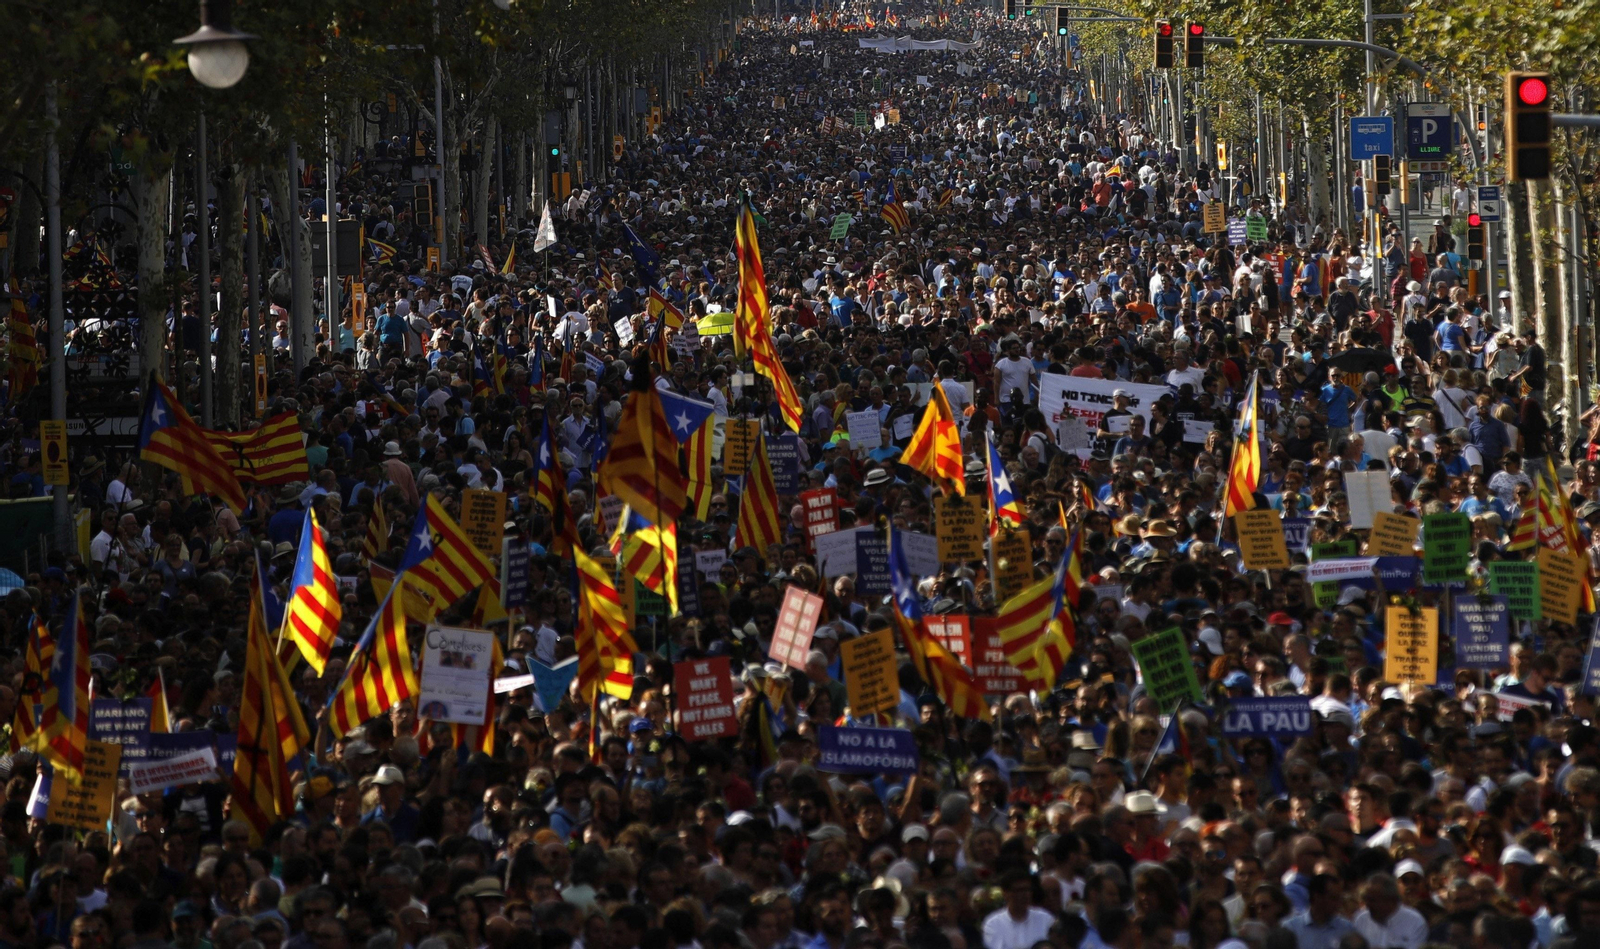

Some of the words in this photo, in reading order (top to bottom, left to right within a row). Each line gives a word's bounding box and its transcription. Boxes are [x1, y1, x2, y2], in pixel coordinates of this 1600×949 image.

[1422, 118, 1439, 144] P
[1364, 143, 1381, 152] taxi
[1061, 389, 1079, 402] NO
[958, 510, 976, 518] VOL
[858, 539, 887, 548] MARIA
[863, 548, 888, 556] VOLE
[871, 565, 885, 573] NO
[1494, 564, 1536, 574] IMAGINA
[862, 574, 892, 582] VENDR
[1464, 613, 1500, 623] VOLEM
[1471, 624, 1494, 634] PAU,
[1411, 639, 1427, 647] PAZ
[1473, 635, 1489, 643] NO
[1463, 644, 1503, 653] VENDRE
[1394, 656, 1431, 664] TRAFICA
[1466, 654, 1500, 663] ARMES
[694, 662, 710, 676] WE
[998, 664, 1022, 677] ARM
[690, 676, 718, 692] WANT
[986, 680, 1018, 692] SALES
[95, 708, 149, 720] MARIANO,
[682, 710, 702, 723] NOT
[703, 706, 733, 721] ARMS
[95, 723, 112, 732] WE
[114, 722, 147, 732] WANT
[1224, 713, 1255, 733] LA
[1261, 712, 1311, 733] PAU
[694, 722, 726, 737] SALES
[101, 735, 140, 746] PEACE,
[838, 732, 861, 747] NO
[865, 735, 877, 748] A
[879, 736, 897, 750] LA
